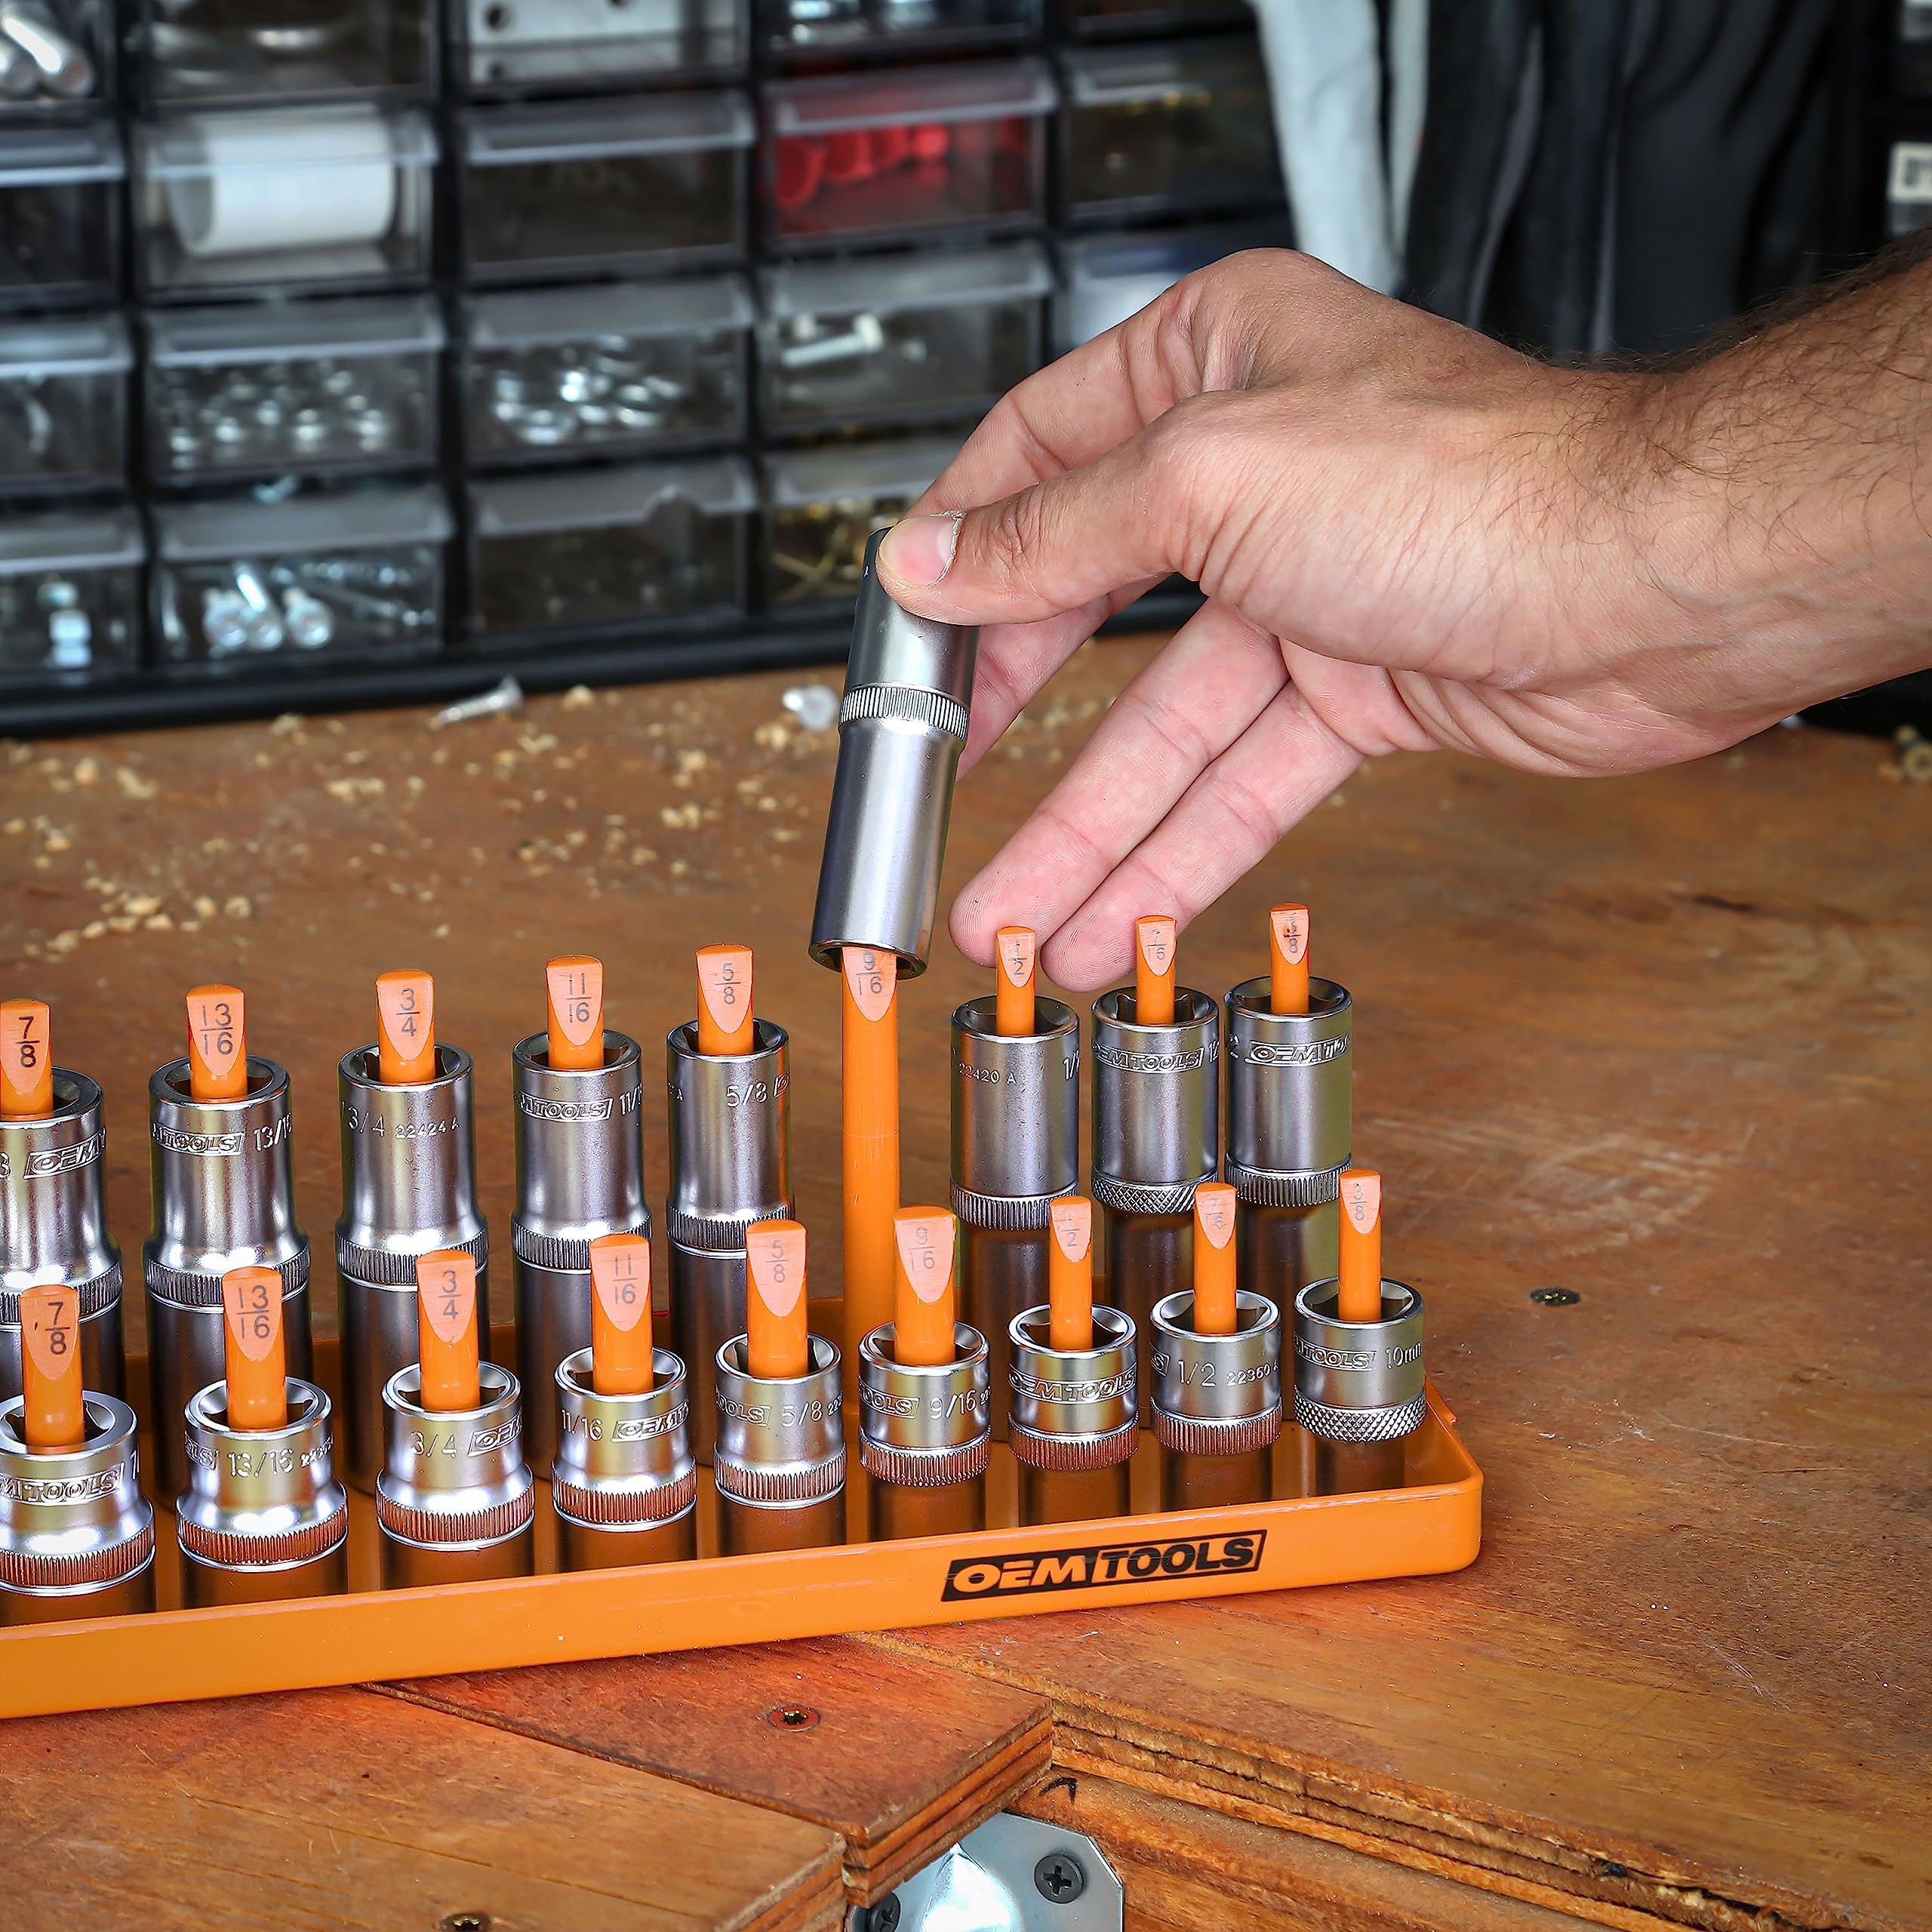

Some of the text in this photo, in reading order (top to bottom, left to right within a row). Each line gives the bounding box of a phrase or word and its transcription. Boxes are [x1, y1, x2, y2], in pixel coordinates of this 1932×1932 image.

[726, 1083, 767, 1107] 5/8
[1177, 1360, 1216, 1387] 1/2
[782, 1401, 822, 1427] 5/8
[931, 1390, 976, 1420] 9/16
[411, 1432, 457, 1458] 3/4
[227, 1448, 293, 1477] 13/16
